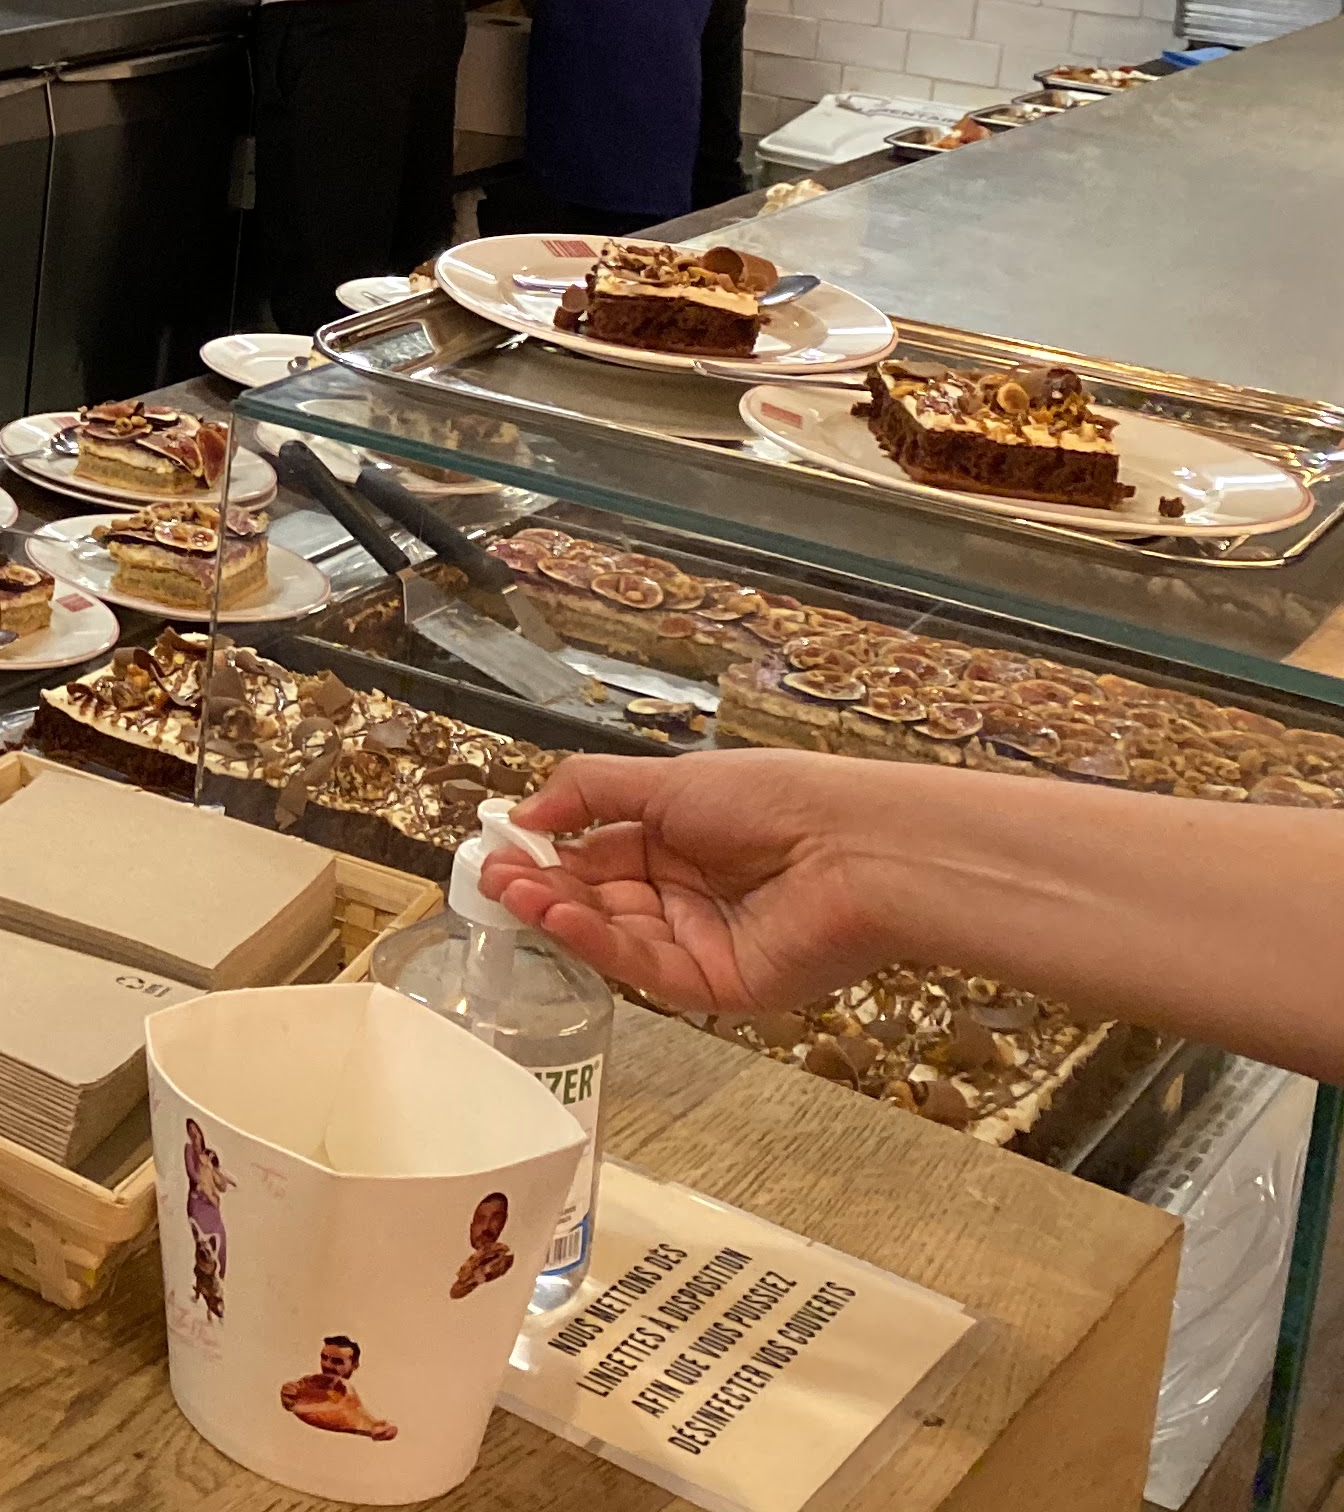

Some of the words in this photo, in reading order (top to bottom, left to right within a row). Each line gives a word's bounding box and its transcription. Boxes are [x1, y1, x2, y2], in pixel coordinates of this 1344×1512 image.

[548, 1318, 603, 1356] NOUS
[585, 1266, 663, 1324] METTONS
[576, 1326, 666, 1398] LINGETTES
[657, 1247, 753, 1322] DISPOSITION
[631, 1378, 684, 1418] AFIN
[664, 1353, 710, 1386] QUE
[689, 1322, 743, 1359] VOUS
[724, 1270, 797, 1328] PUISSIEZ
[668, 1364, 774, 1455] DÉSINFECTER
[751, 1339, 798, 1370] VOS
[778, 1281, 857, 1345] COUVERTS
